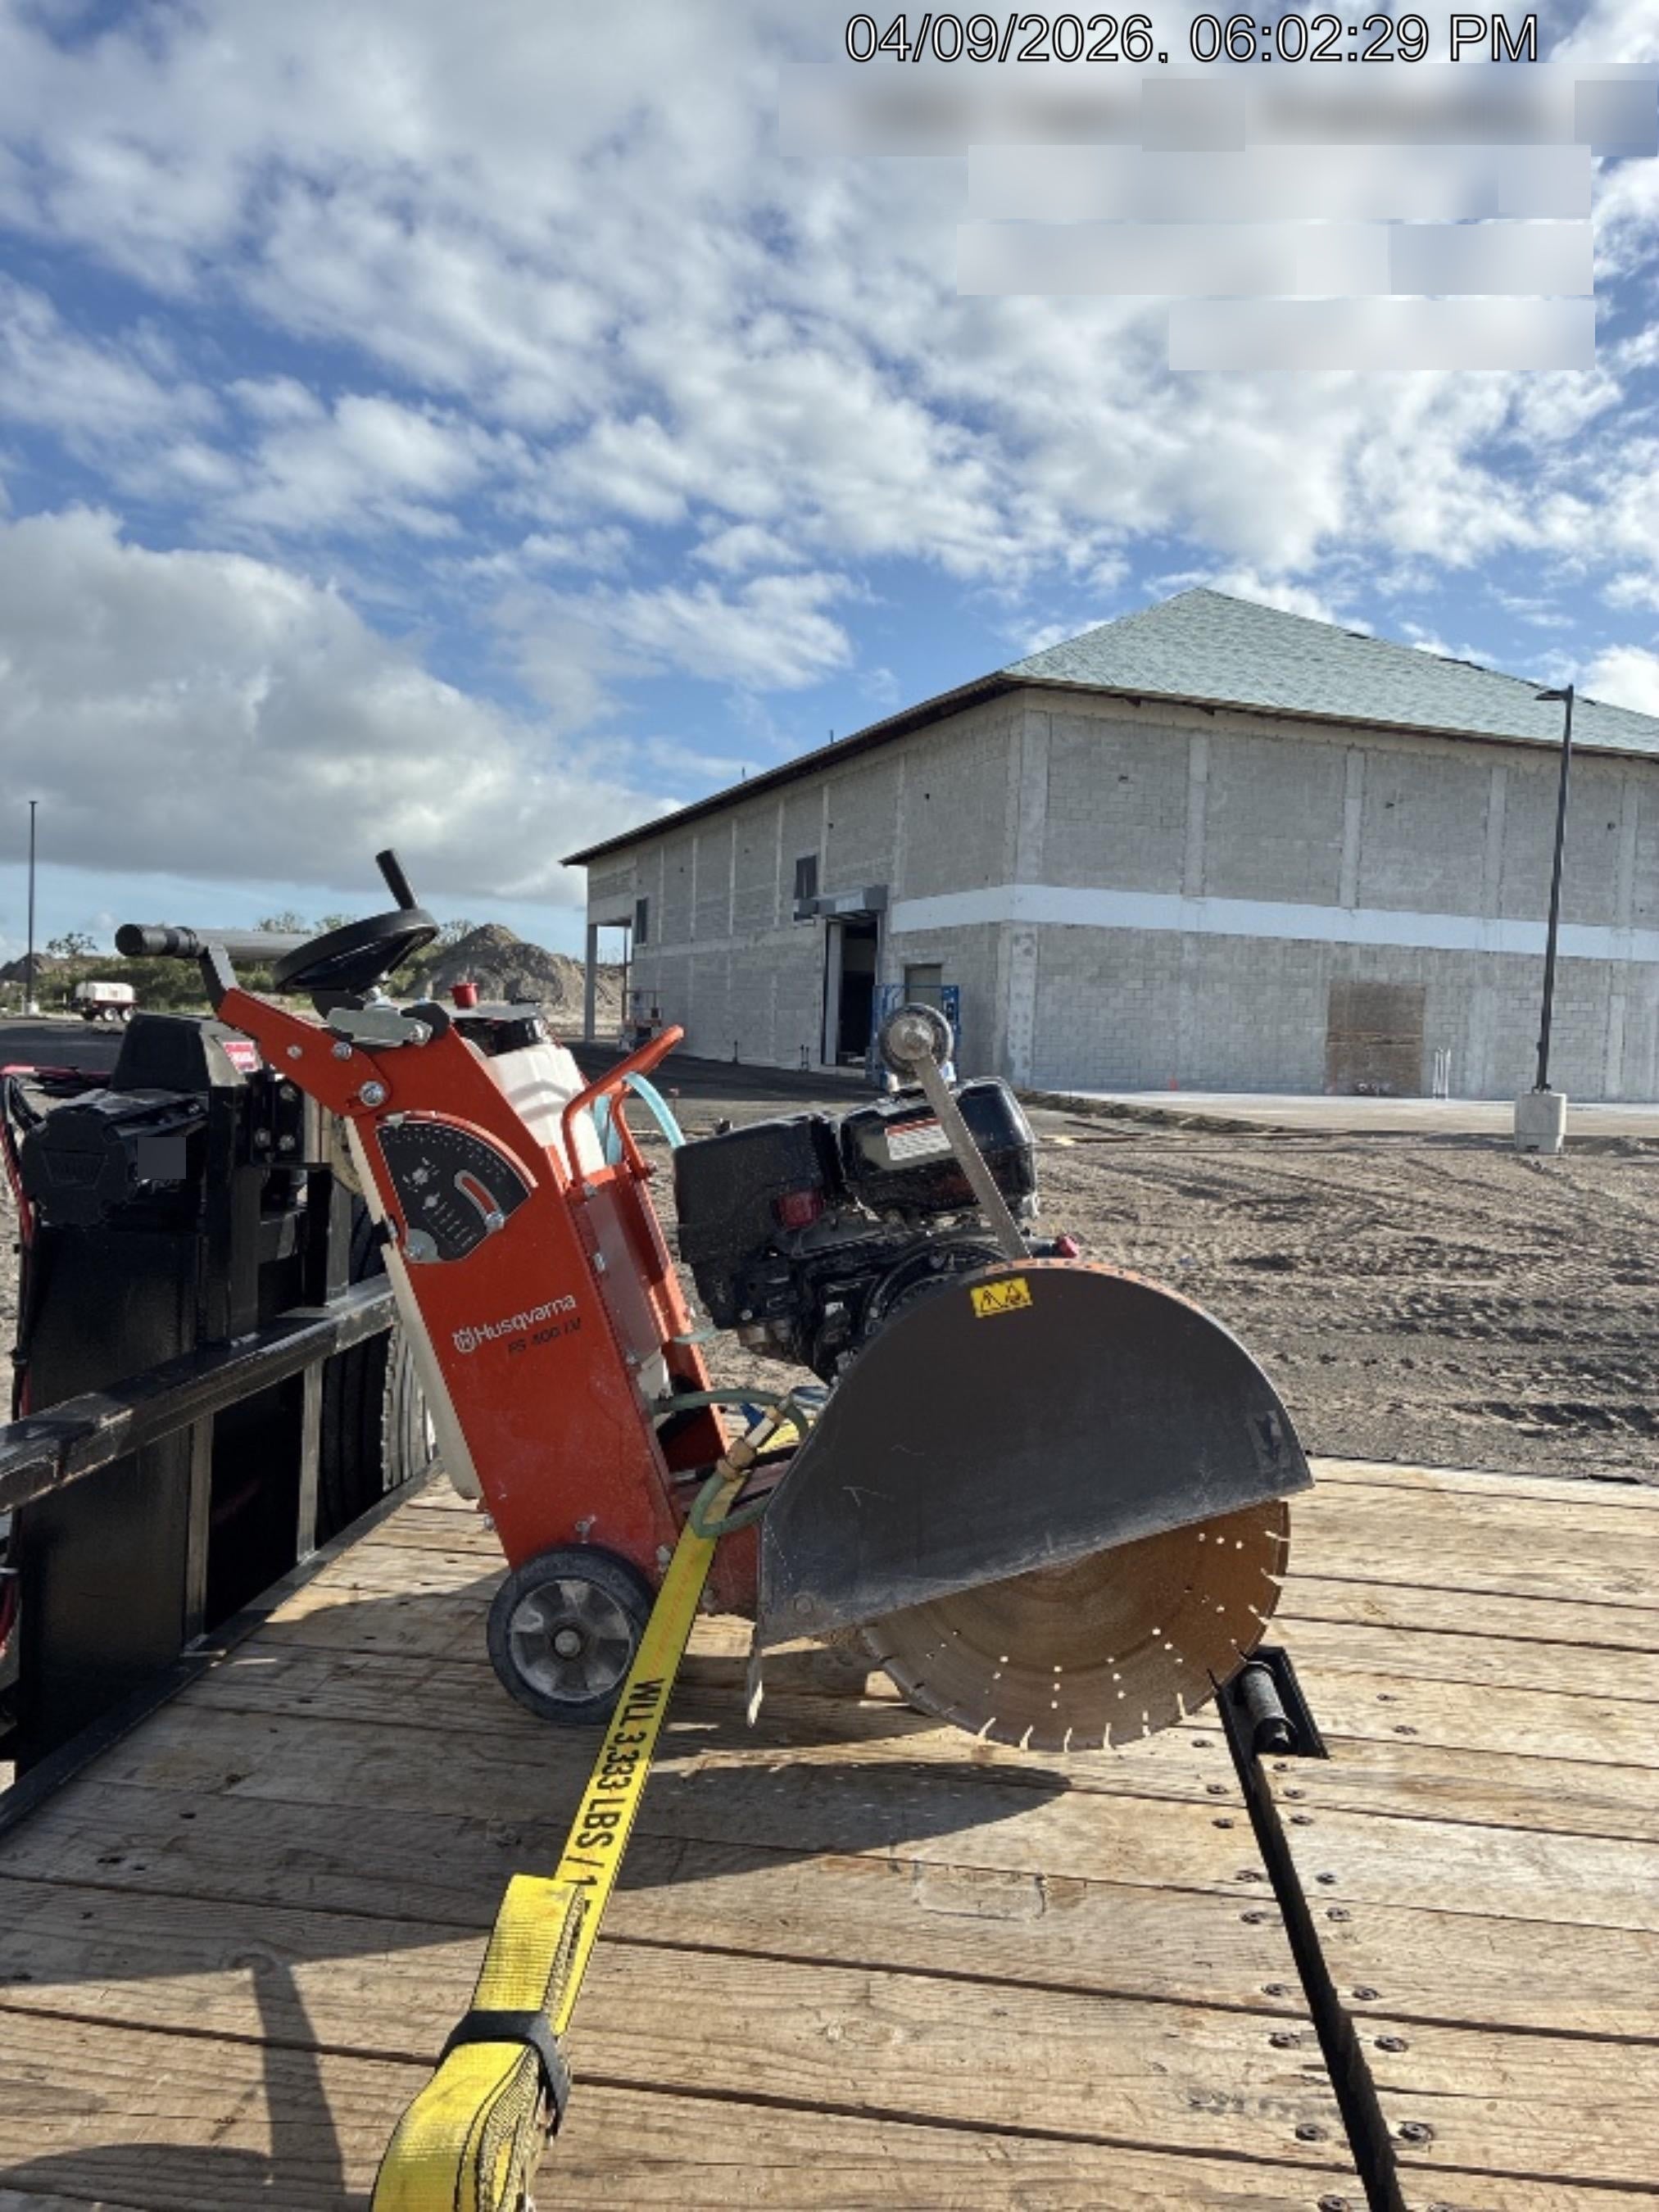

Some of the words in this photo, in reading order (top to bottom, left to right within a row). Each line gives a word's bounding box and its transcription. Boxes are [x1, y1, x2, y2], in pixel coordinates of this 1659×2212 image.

[473, 1294, 577, 1344] Husqvarna
[619, 1678, 665, 1726] WLL
[596, 1731, 647, 1791] 3,333
[574, 1798, 626, 1849] LBS
[564, 1855, 605, 1869] /
